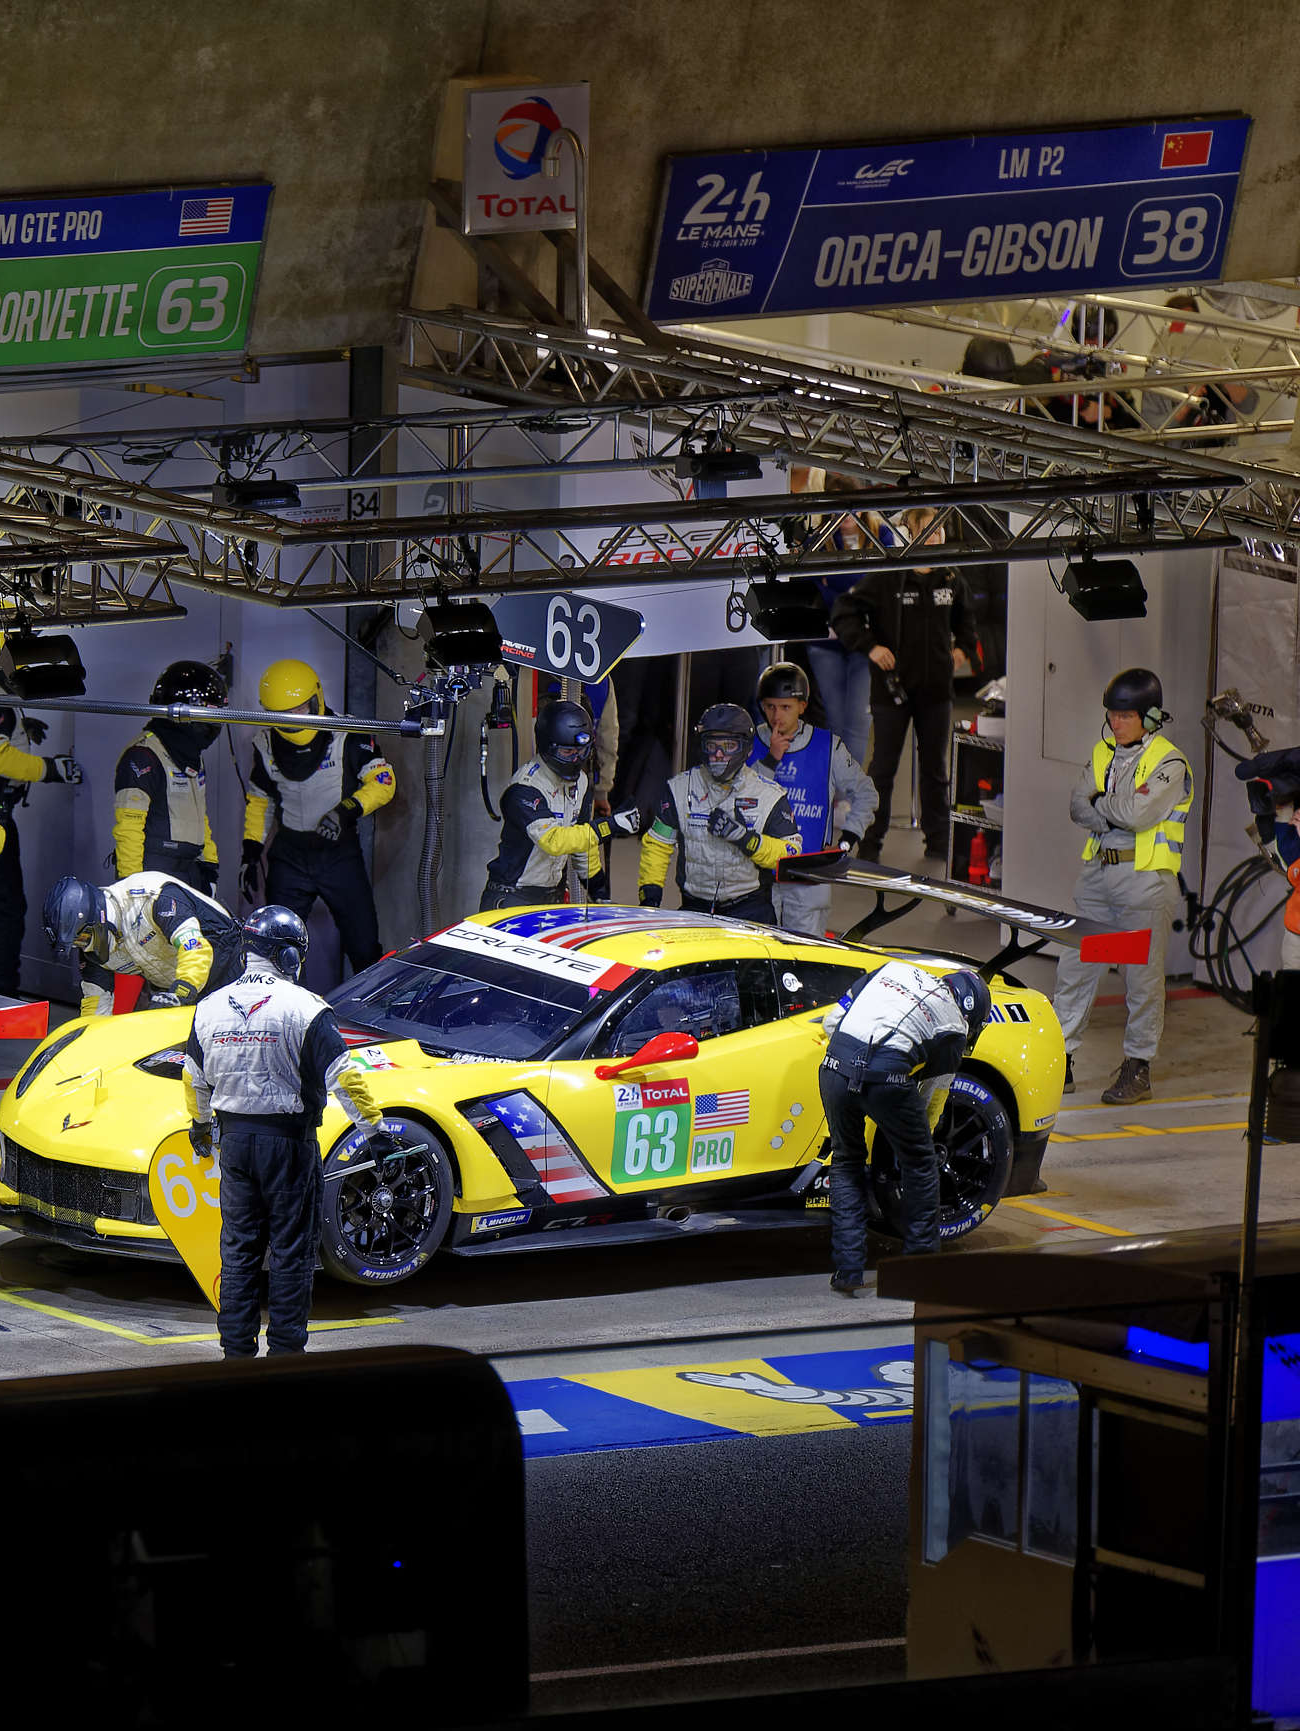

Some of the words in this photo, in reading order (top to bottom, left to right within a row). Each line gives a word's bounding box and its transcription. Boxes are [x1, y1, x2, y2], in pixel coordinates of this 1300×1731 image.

[854, 158, 916, 180] WEC
[998, 148, 1031, 180] LM
[1039, 145, 1066, 177] P2
[476, 193, 577, 218] TOTAL
[20, 212, 59, 244] GTE
[62, 209, 104, 241] PRO
[676, 227, 703, 241] LE
[704, 224, 762, 239] MANS
[813, 215, 1105, 289] ORECA-GIBSON
[1131, 205, 1210, 265] 38
[671, 269, 752, 304] SUPERFINALE
[156, 275, 230, 335] 63
[352, 491, 379, 517] 34
[546, 595, 602, 677] 63
[793, 802, 824, 819] TRACK
[444, 928, 602, 973] CORVETTE
[212, 1030, 282, 1039] CORVETTE
[212, 1037, 278, 1045] RACING
[643, 1087, 688, 1100] TOTAL
[624, 1109, 679, 1176] 63
[692, 1136, 732, 1169] PRO
[488, 1214, 526, 1228] MICHELIN
[361, 1264, 413, 1280] MICHELIN
